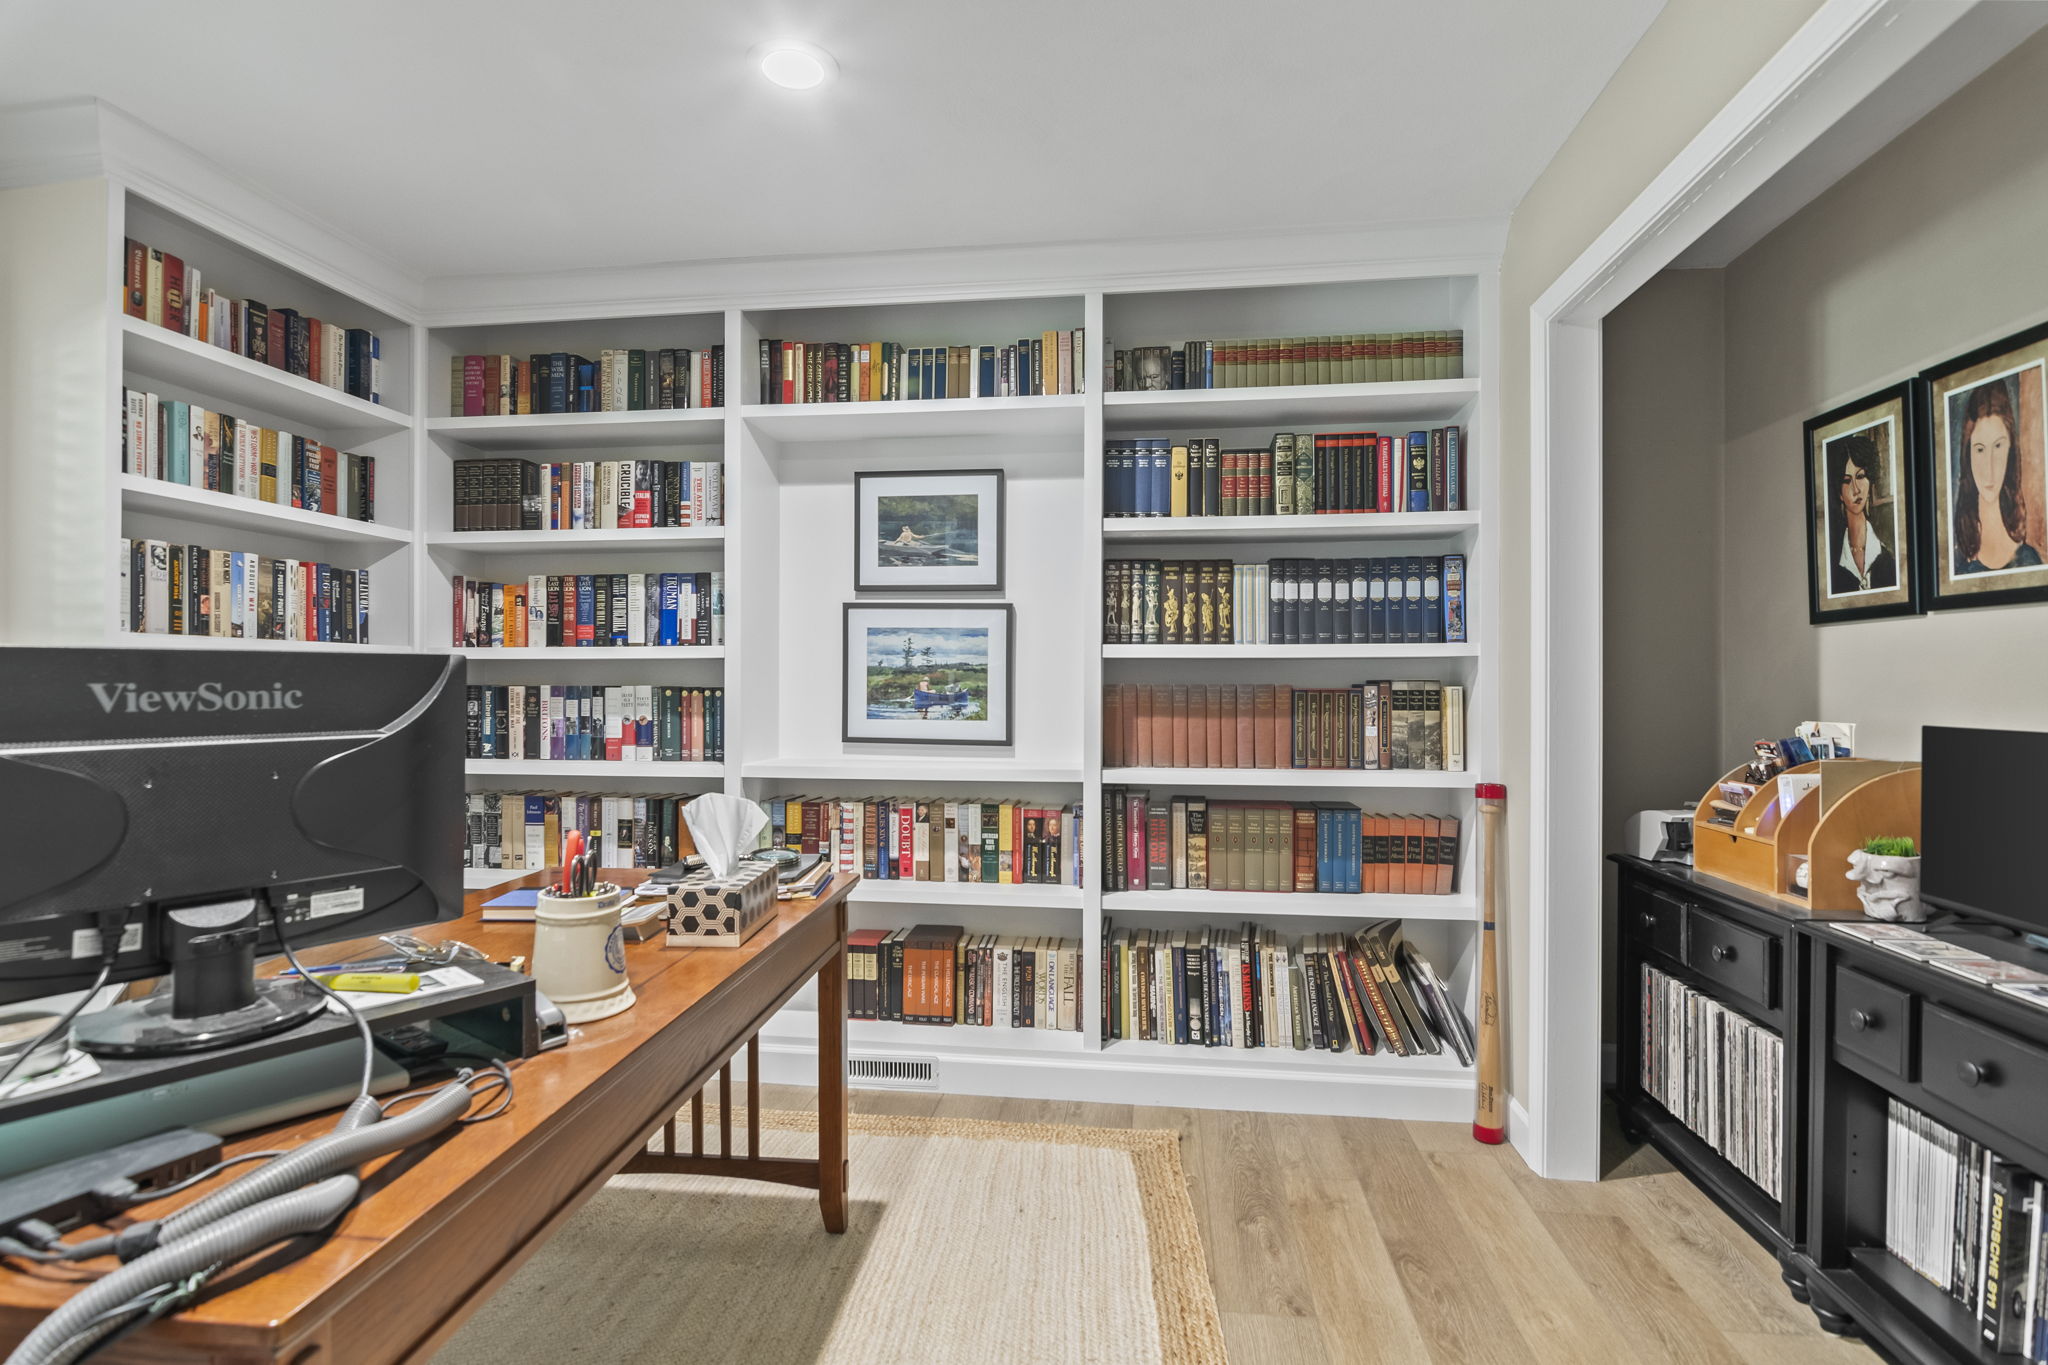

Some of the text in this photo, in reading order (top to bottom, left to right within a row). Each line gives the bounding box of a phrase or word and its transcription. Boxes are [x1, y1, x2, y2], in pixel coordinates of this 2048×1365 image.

[168, 276, 181, 322] HITLER
[136, 421, 142, 429] NO
[621, 464, 630, 506] CRUCIBLE
[674, 477, 679, 486] NO
[321, 573, 330, 595] 1960
[360, 584, 368, 613] LINCOLN
[667, 576, 677, 609] TRUMAN
[481, 606, 489, 631] Essays
[597, 590, 605, 625] CHURCHILL
[613, 598, 626, 632] CHURCHILL
[87, 682, 303, 713] ViewSonic
[865, 805, 875, 844] WARLORD
[901, 816, 910, 857] DOUBT
[1106, 846, 1111, 854] DA
[1159, 819, 1167, 863] MILITARY
[1049, 962, 1054, 972] ON
[1064, 977, 1074, 1005] FALL
[1242, 975, 1252, 1011] MARINES
[1308, 977, 1316, 999] ENGLISH
[1986, 1193, 2004, 1310] PORSCHE 911
